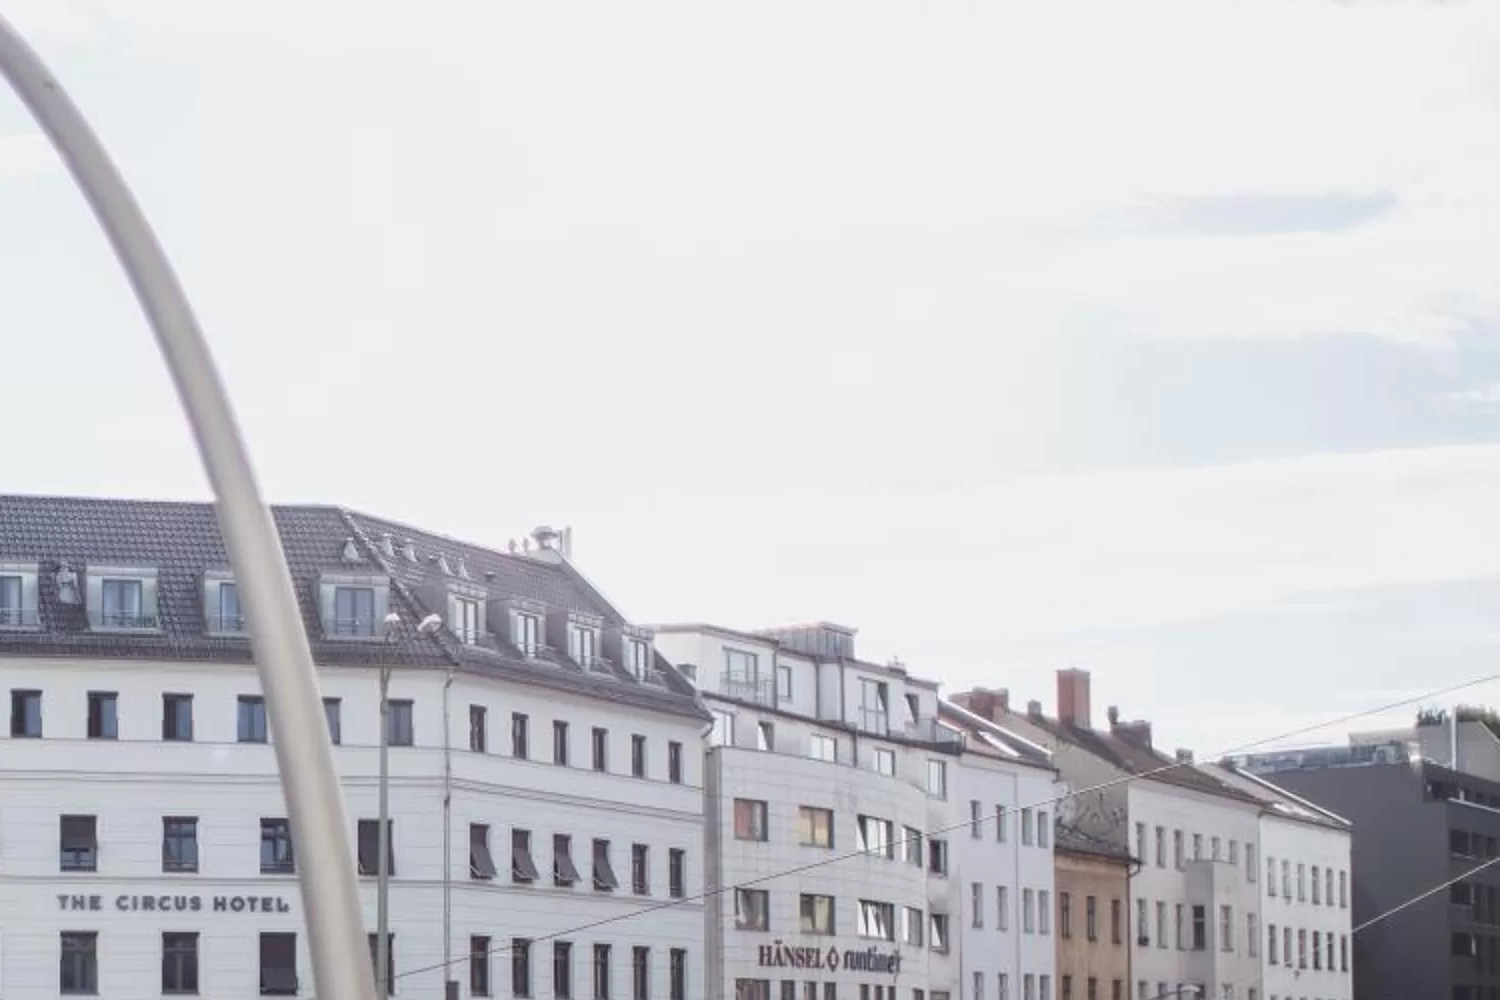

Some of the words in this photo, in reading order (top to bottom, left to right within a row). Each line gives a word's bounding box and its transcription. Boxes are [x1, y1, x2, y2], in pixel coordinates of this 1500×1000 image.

[56, 894, 102, 910] THE
[115, 894, 202, 911] CIRCUS
[213, 895, 290, 912] HOTEL
[758, 939, 824, 969] HÄNSEL
